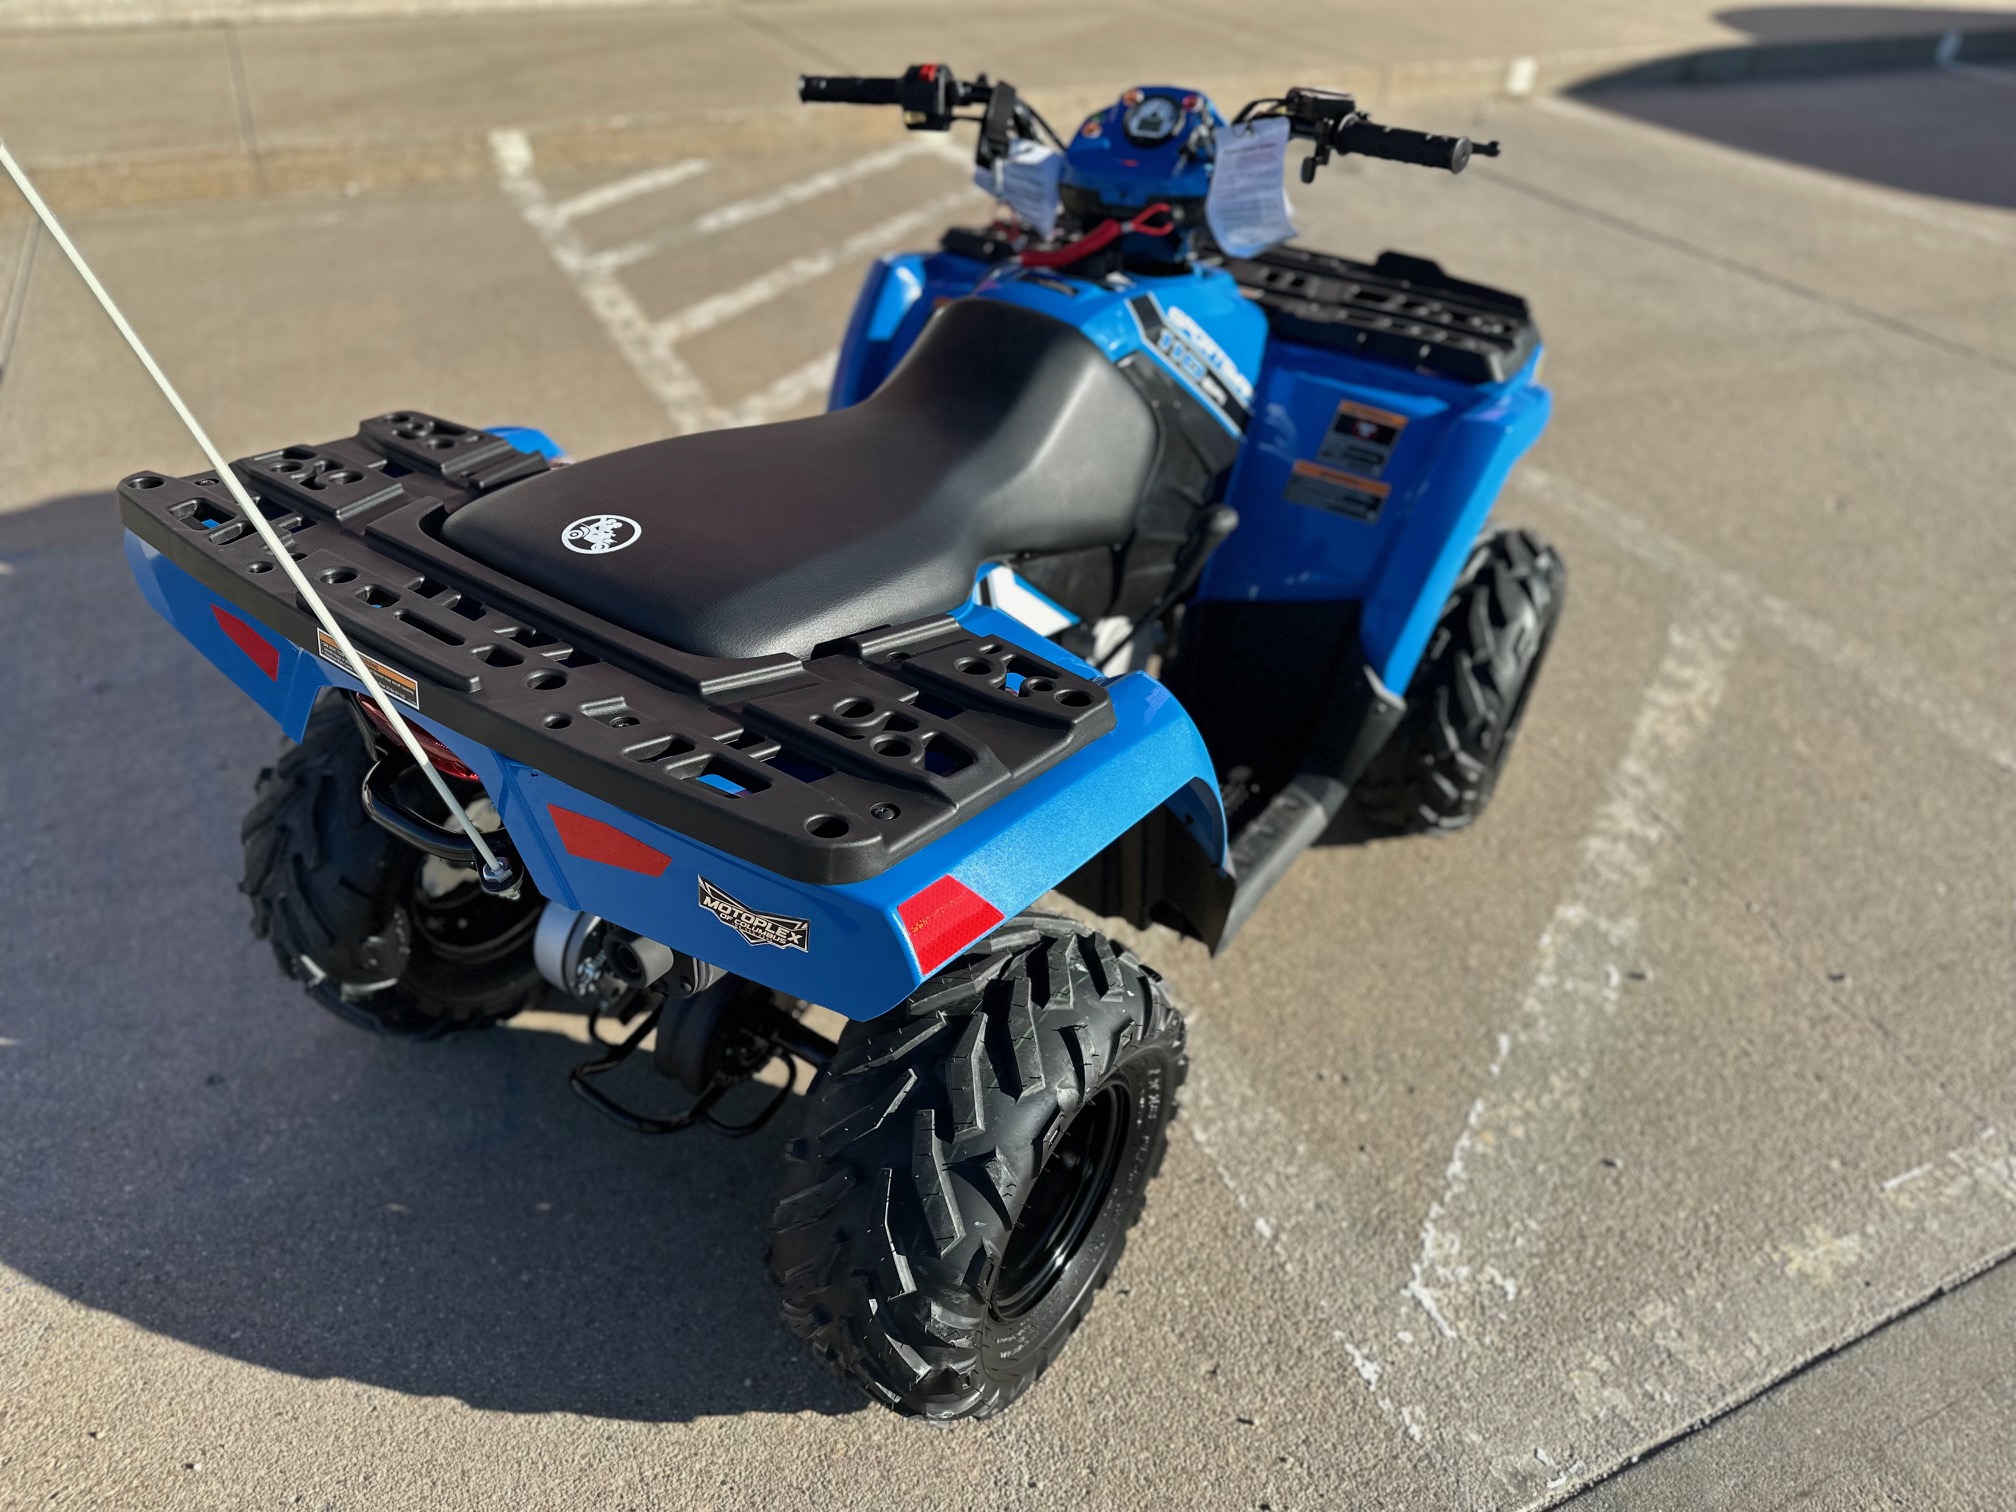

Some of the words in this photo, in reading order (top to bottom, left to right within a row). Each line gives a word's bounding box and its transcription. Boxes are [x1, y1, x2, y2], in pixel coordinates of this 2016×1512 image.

[703, 896, 802, 944] MOTOPLEX
[719, 912, 734, 921] OF
[734, 919, 787, 944] COLUMBUS
